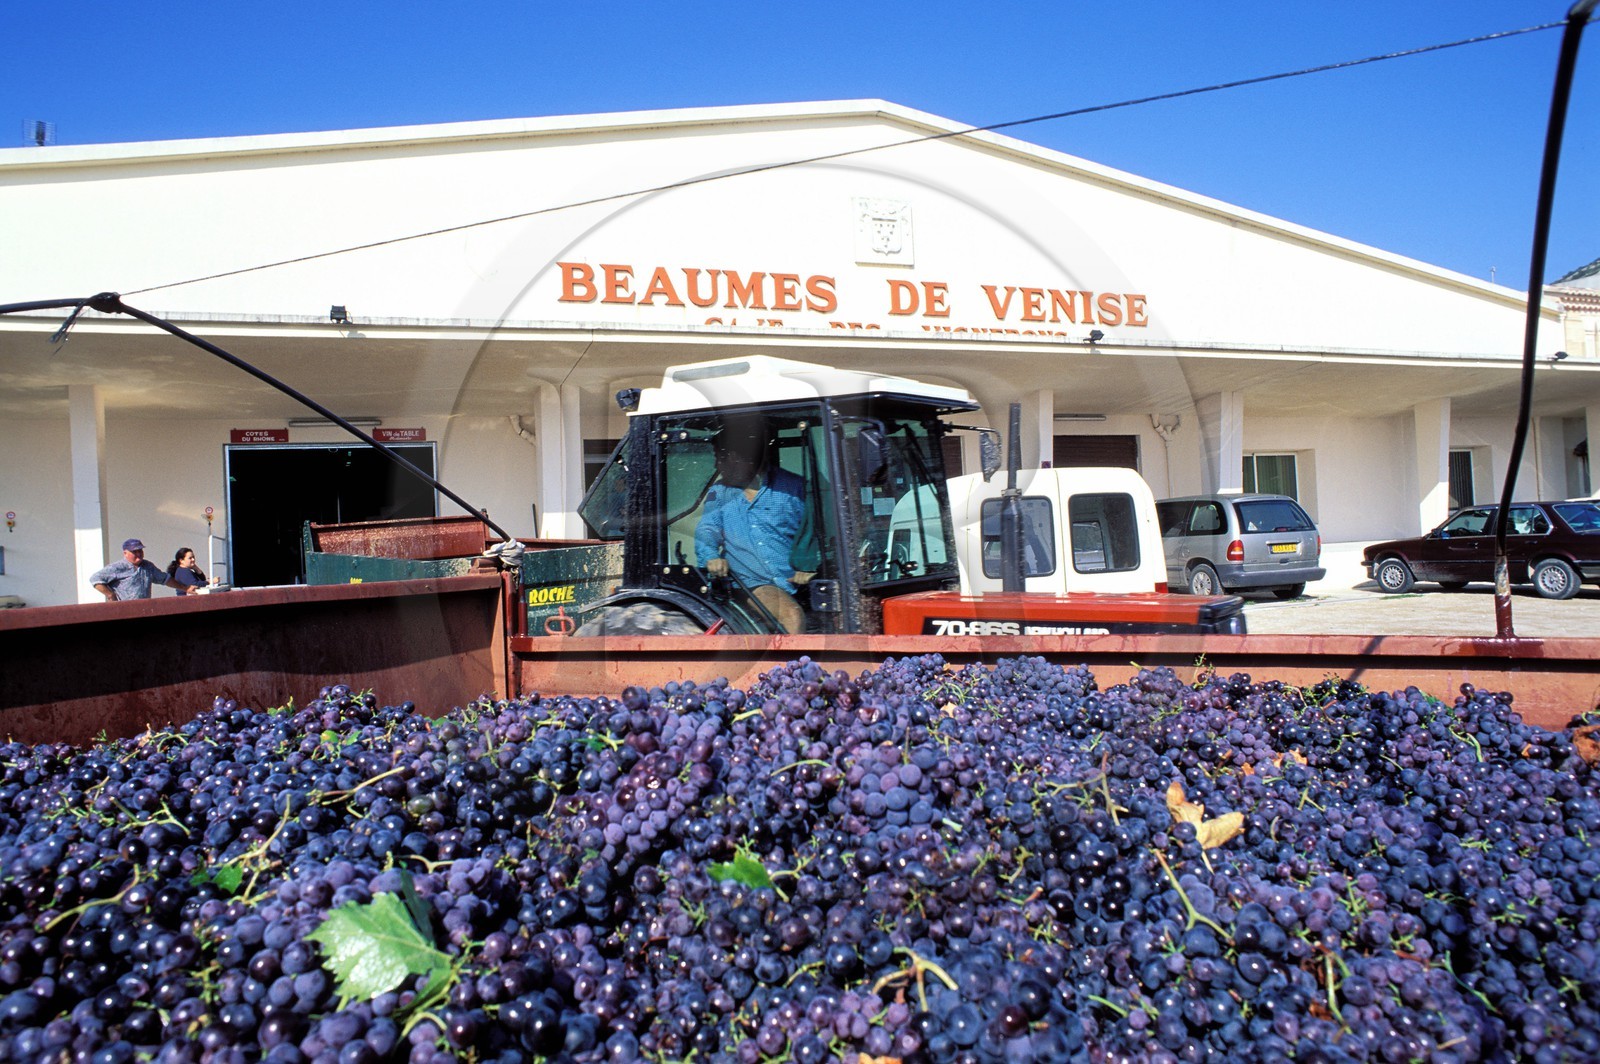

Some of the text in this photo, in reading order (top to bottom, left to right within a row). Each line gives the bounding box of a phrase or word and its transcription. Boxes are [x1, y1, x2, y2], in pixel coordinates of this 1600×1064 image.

[555, 261, 1149, 327] BEAUMES DE VENISE
[529, 585, 575, 604] ROCHE
